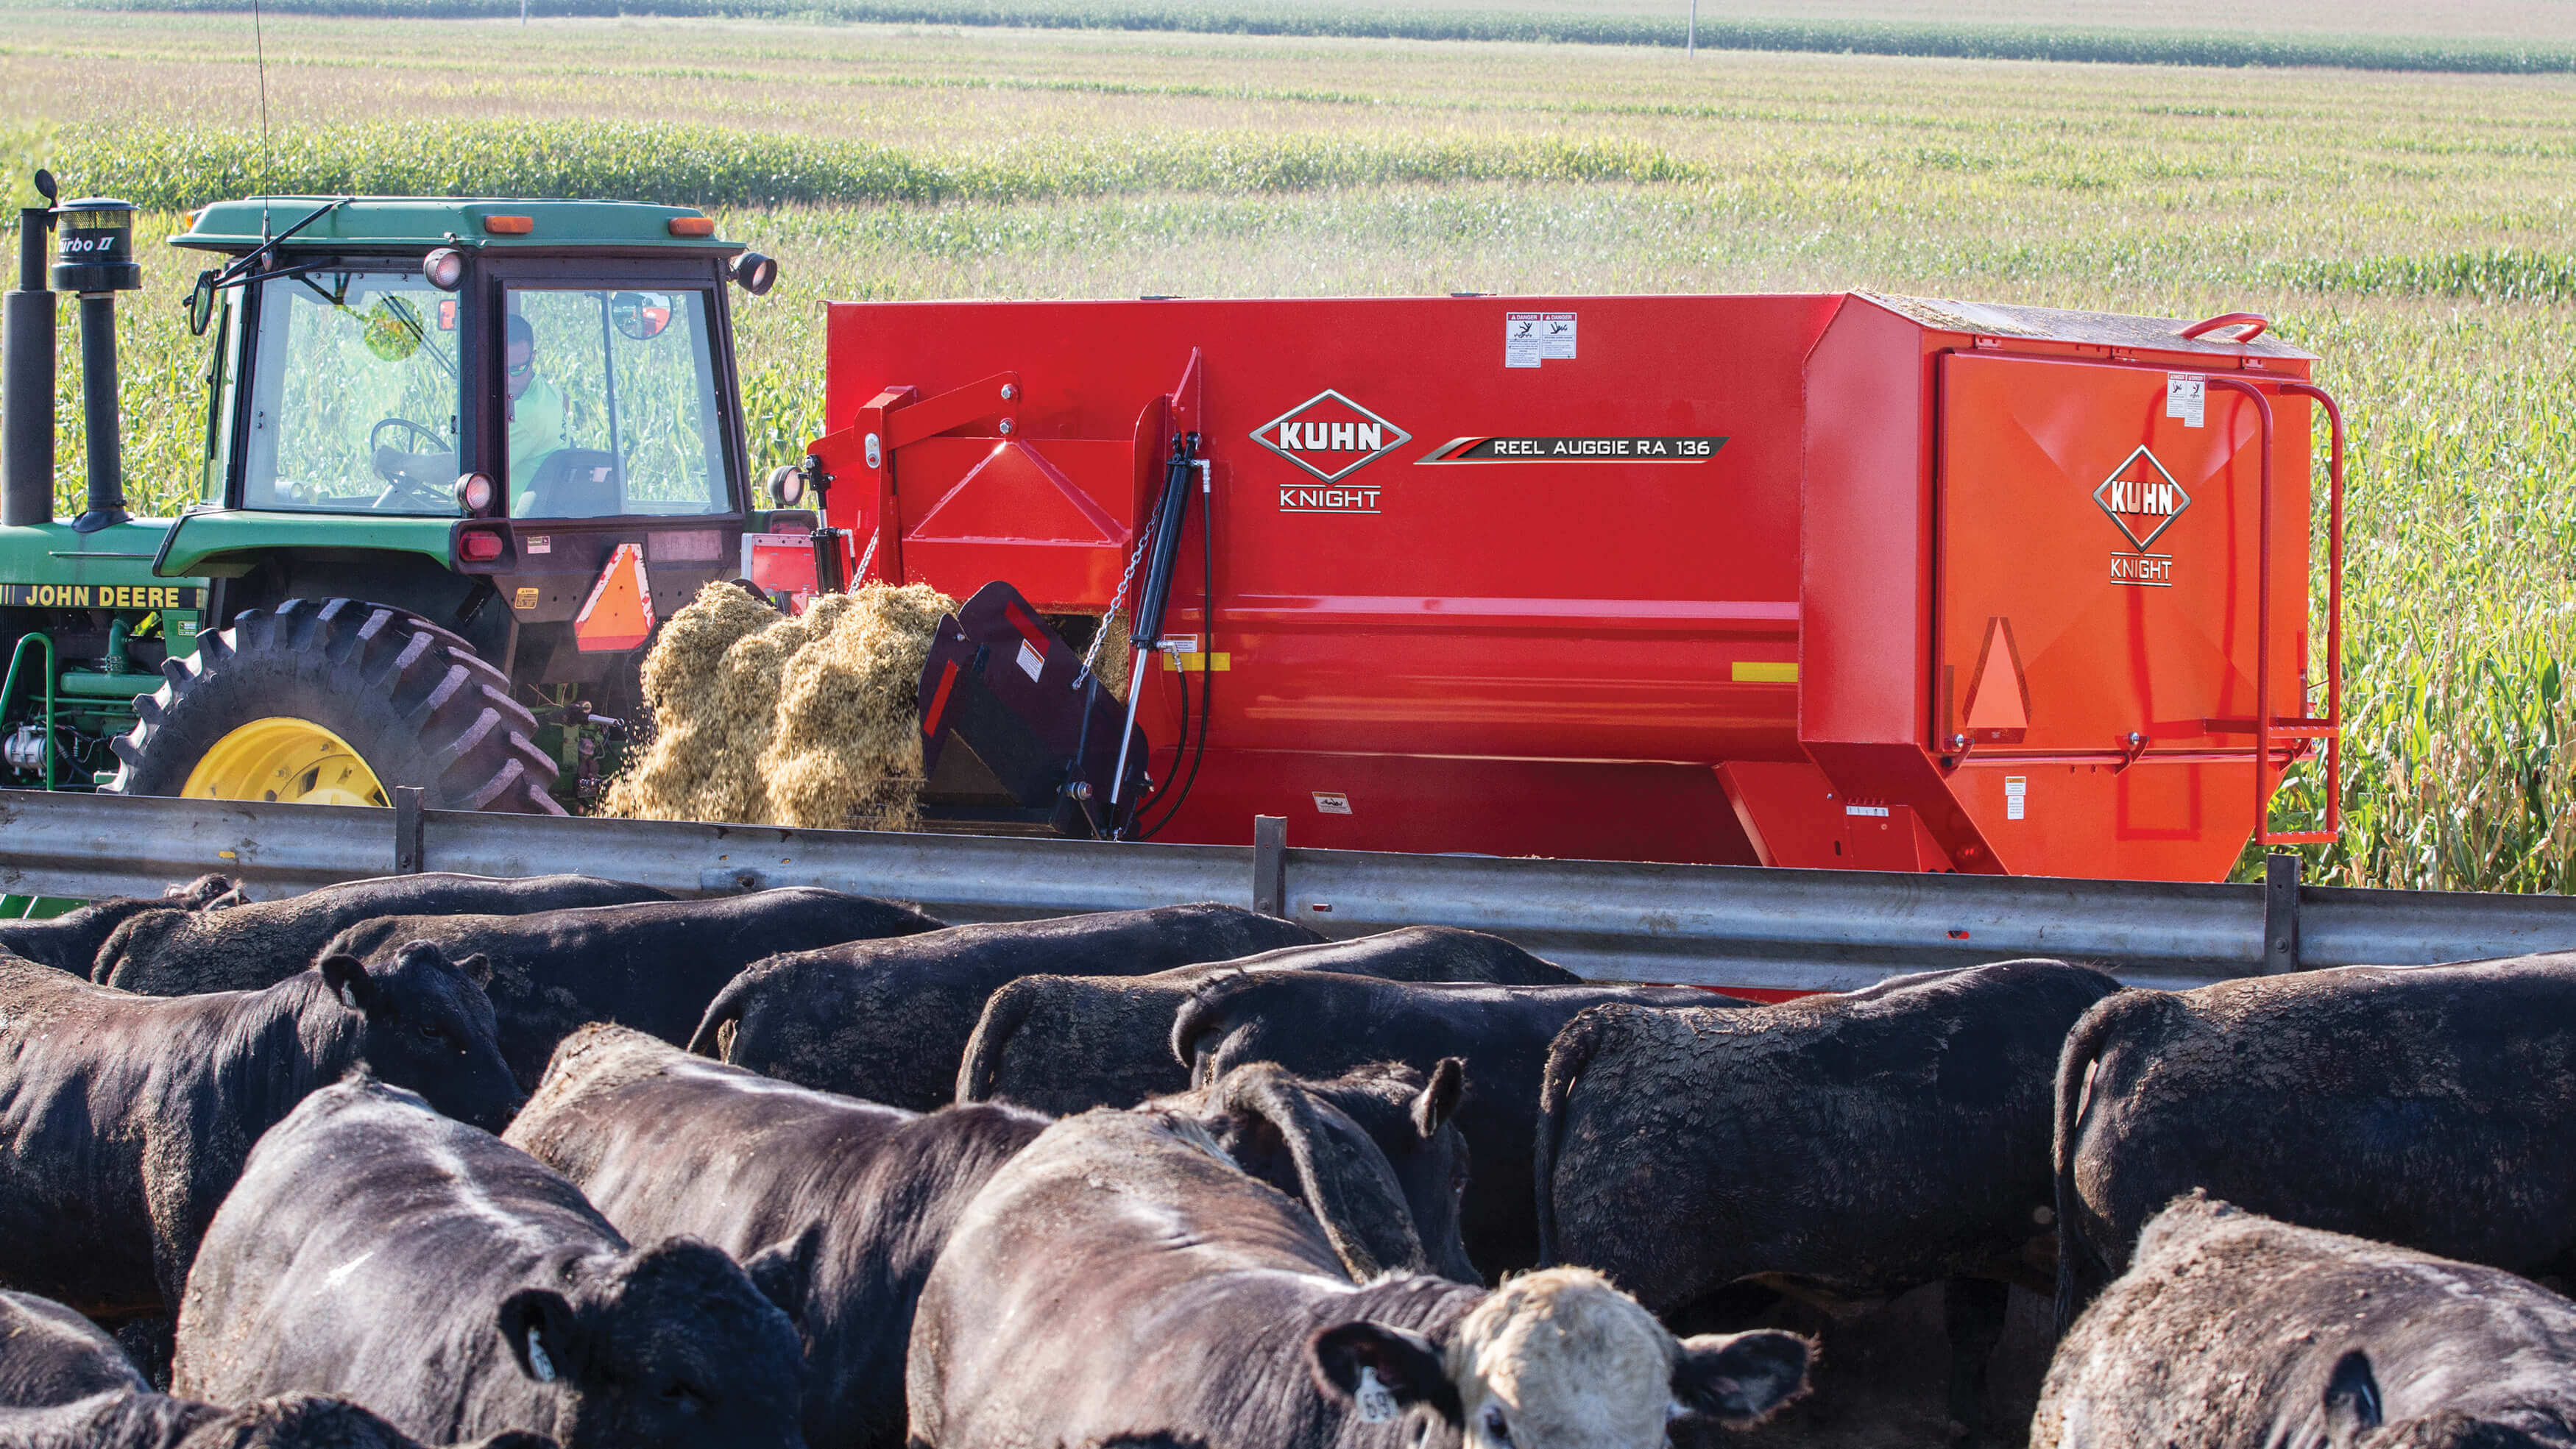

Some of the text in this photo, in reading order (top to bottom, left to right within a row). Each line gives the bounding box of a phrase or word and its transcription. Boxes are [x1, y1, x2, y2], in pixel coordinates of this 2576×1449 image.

[96, 236, 115, 251] II
[1279, 422, 1381, 450] KUHN
[1494, 441, 1710, 455] REEL AUGGIE RA 136
[1279, 489, 1381, 508] KNIGHT
[2112, 481, 2173, 515] KUHN
[2111, 558, 2172, 580] KNIGHT
[25, 585, 179, 608] JOHN DEERE
